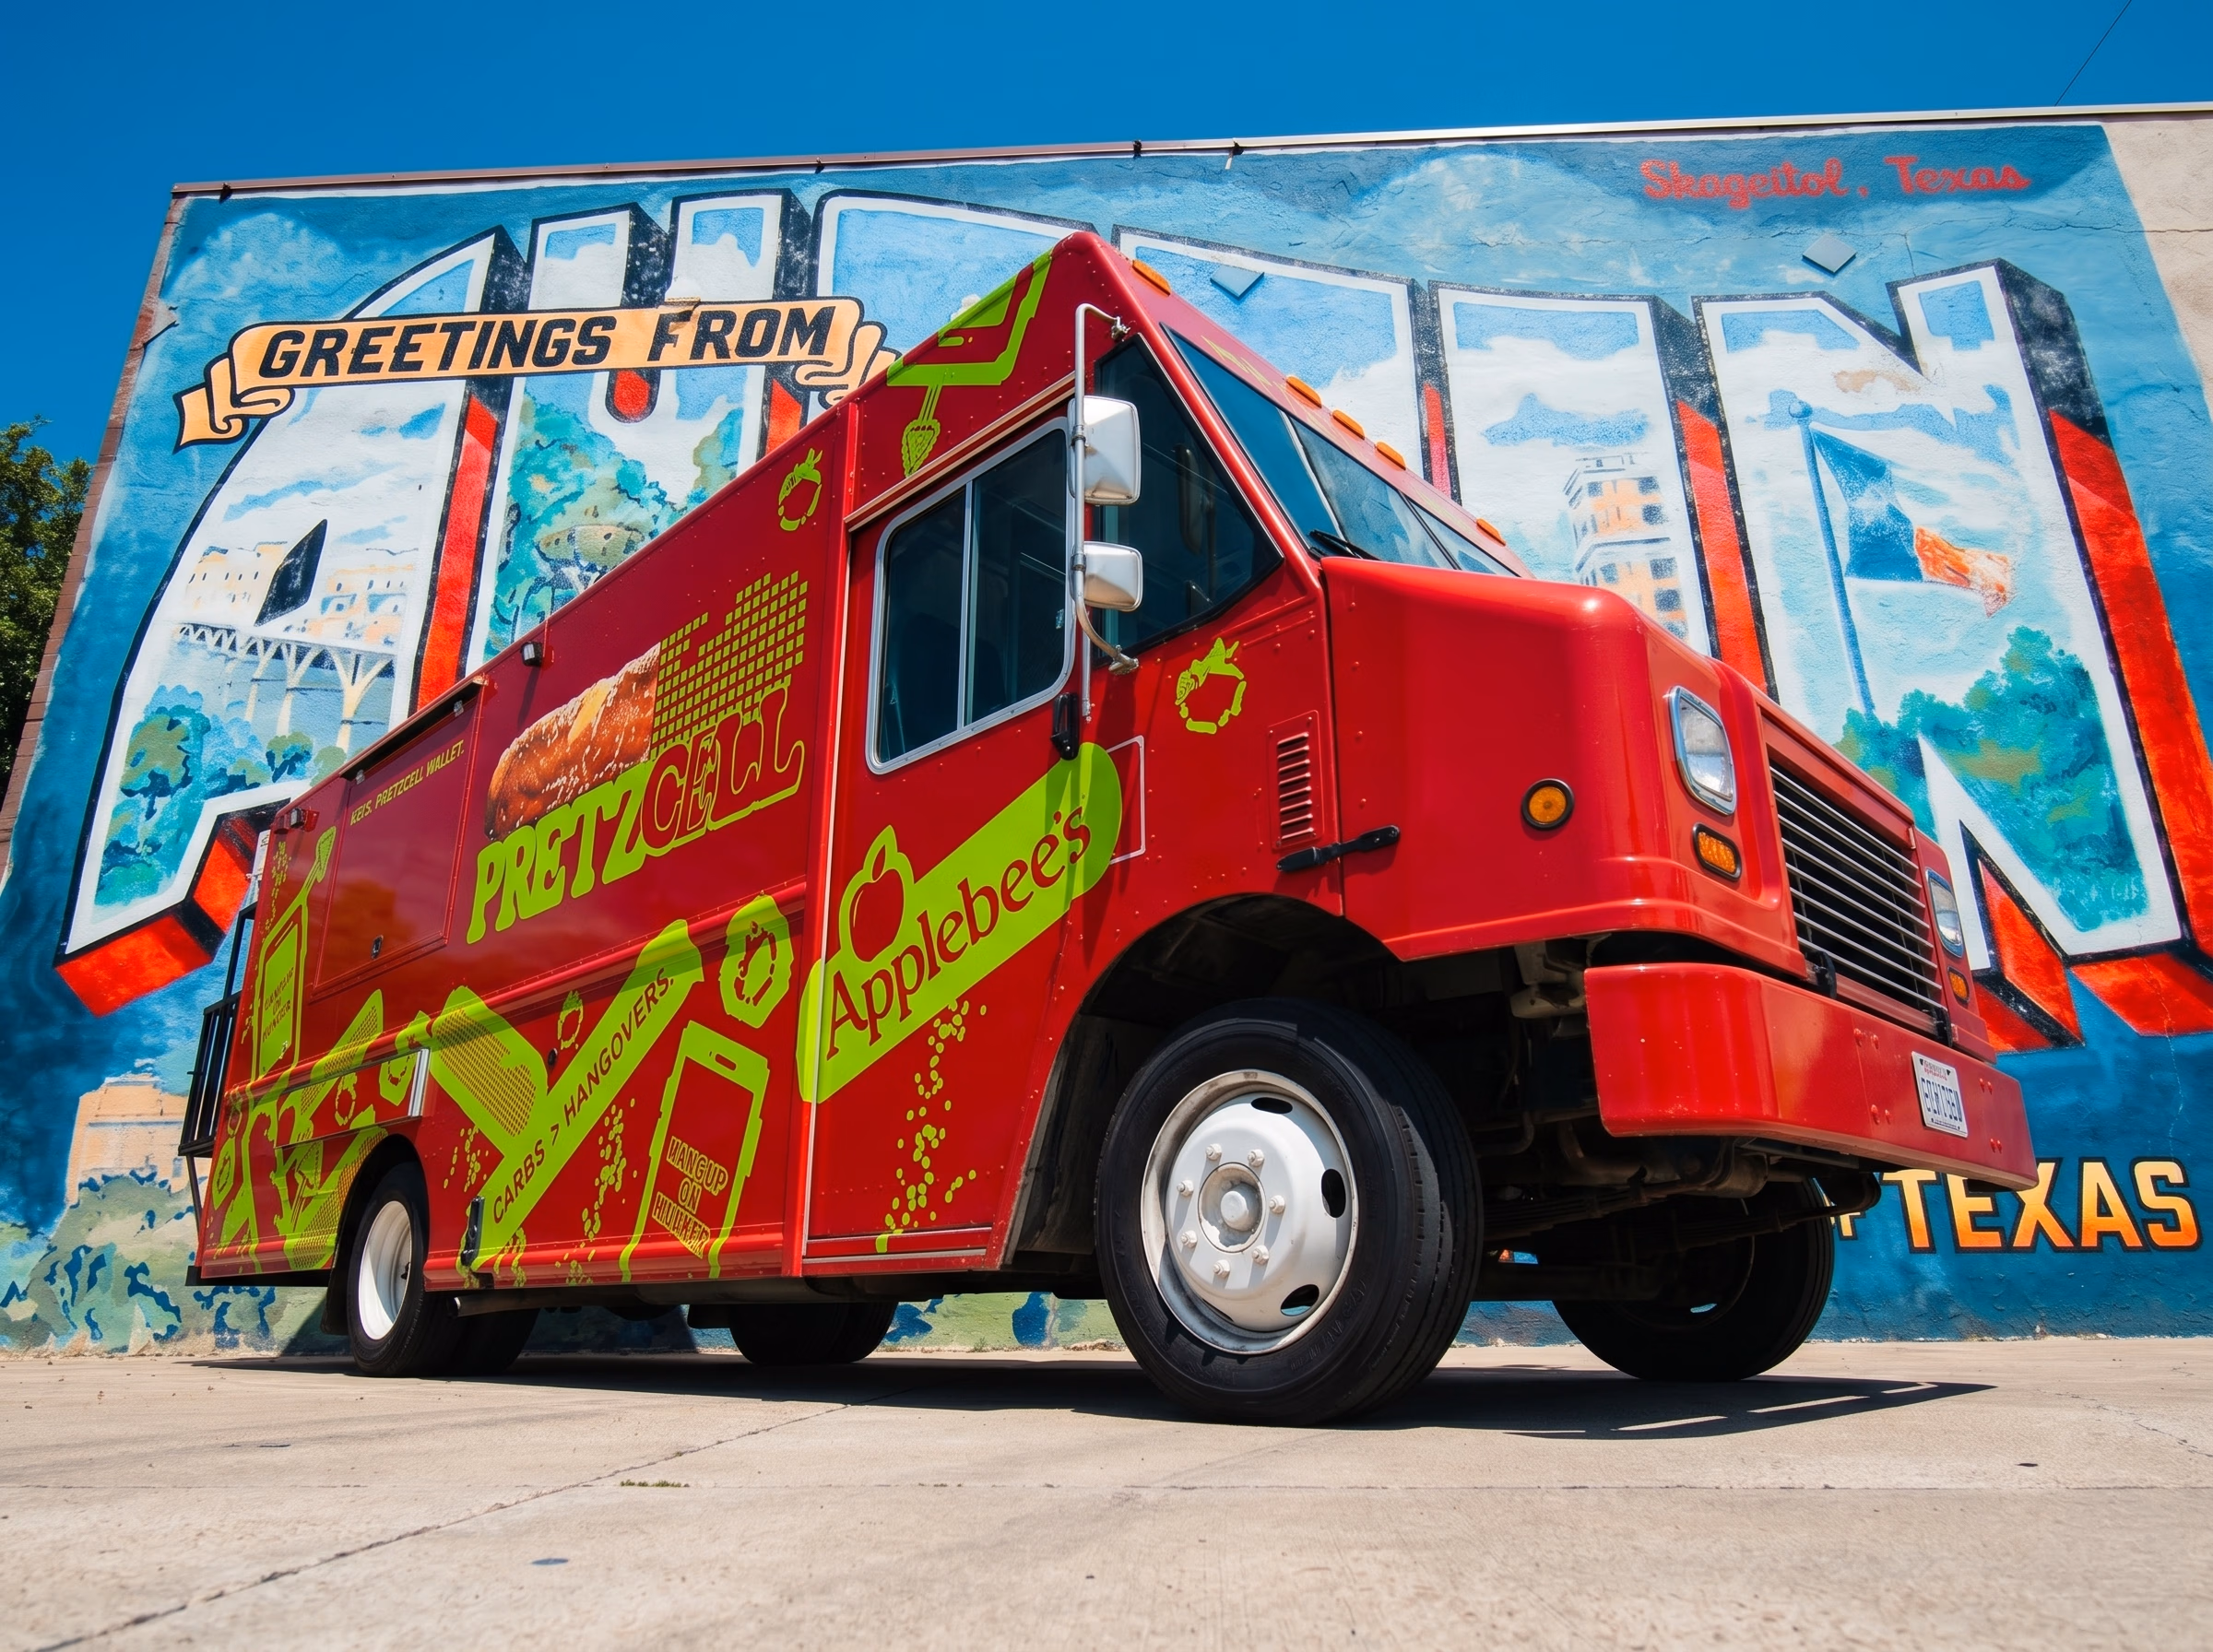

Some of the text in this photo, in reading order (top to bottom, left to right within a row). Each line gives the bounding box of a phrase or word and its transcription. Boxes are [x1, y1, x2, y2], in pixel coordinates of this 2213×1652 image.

[1883, 155, 2031, 195] Texas
[257, 305, 837, 379] GREETINGS FROM
[467, 686, 806, 945] PRETZCELL
[826, 806, 1092, 1061] Applebee's
[492, 1139, 546, 1224] CARBS
[563, 967, 675, 1127] HANGOVERS.
[679, 1176, 703, 1215] ON
[1878, 1156, 2204, 1254] TEXAS
